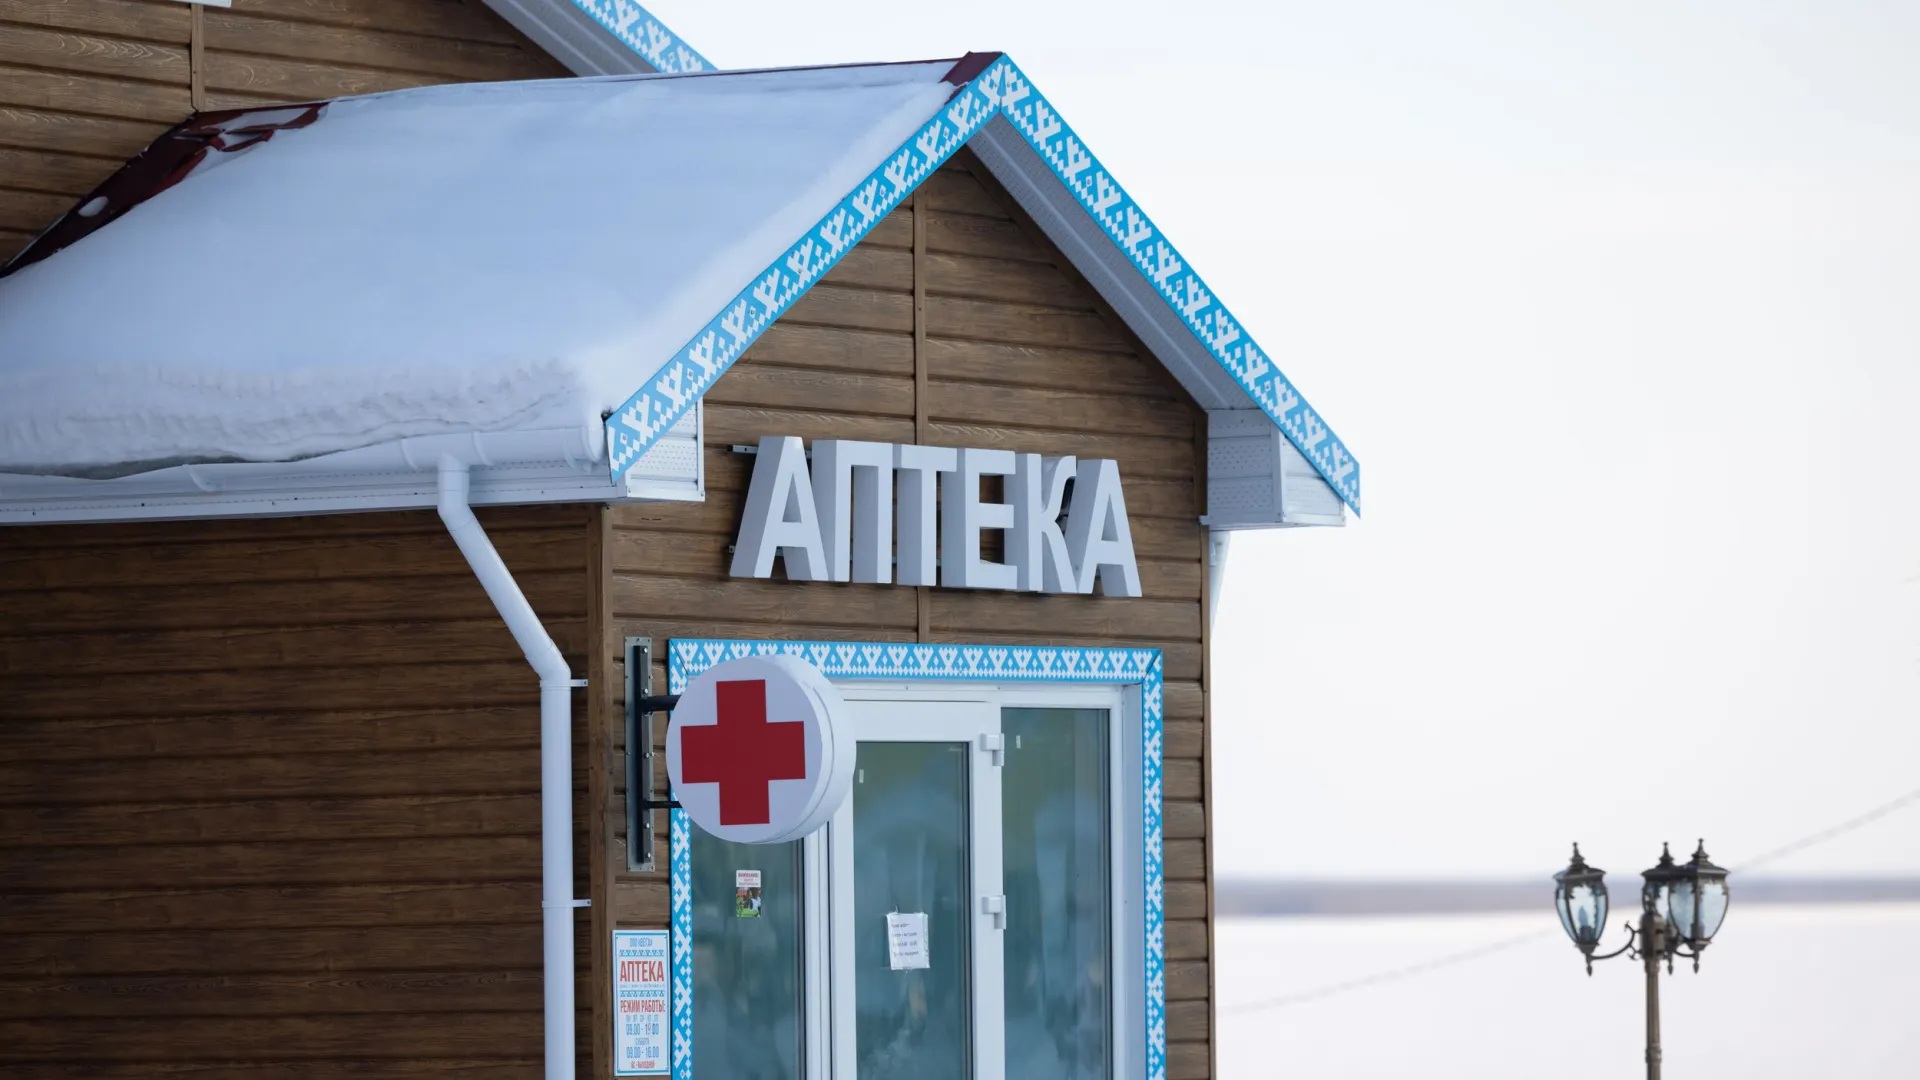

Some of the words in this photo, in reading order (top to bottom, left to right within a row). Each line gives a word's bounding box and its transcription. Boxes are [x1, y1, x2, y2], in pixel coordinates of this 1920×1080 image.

[729, 436, 1142, 597] АПТЕКА
[619, 960, 665, 982] АПТЕКА
[620, 999, 640, 1013] РЕЖИМ
[641, 999, 665, 1013] РАБОТЫ:
